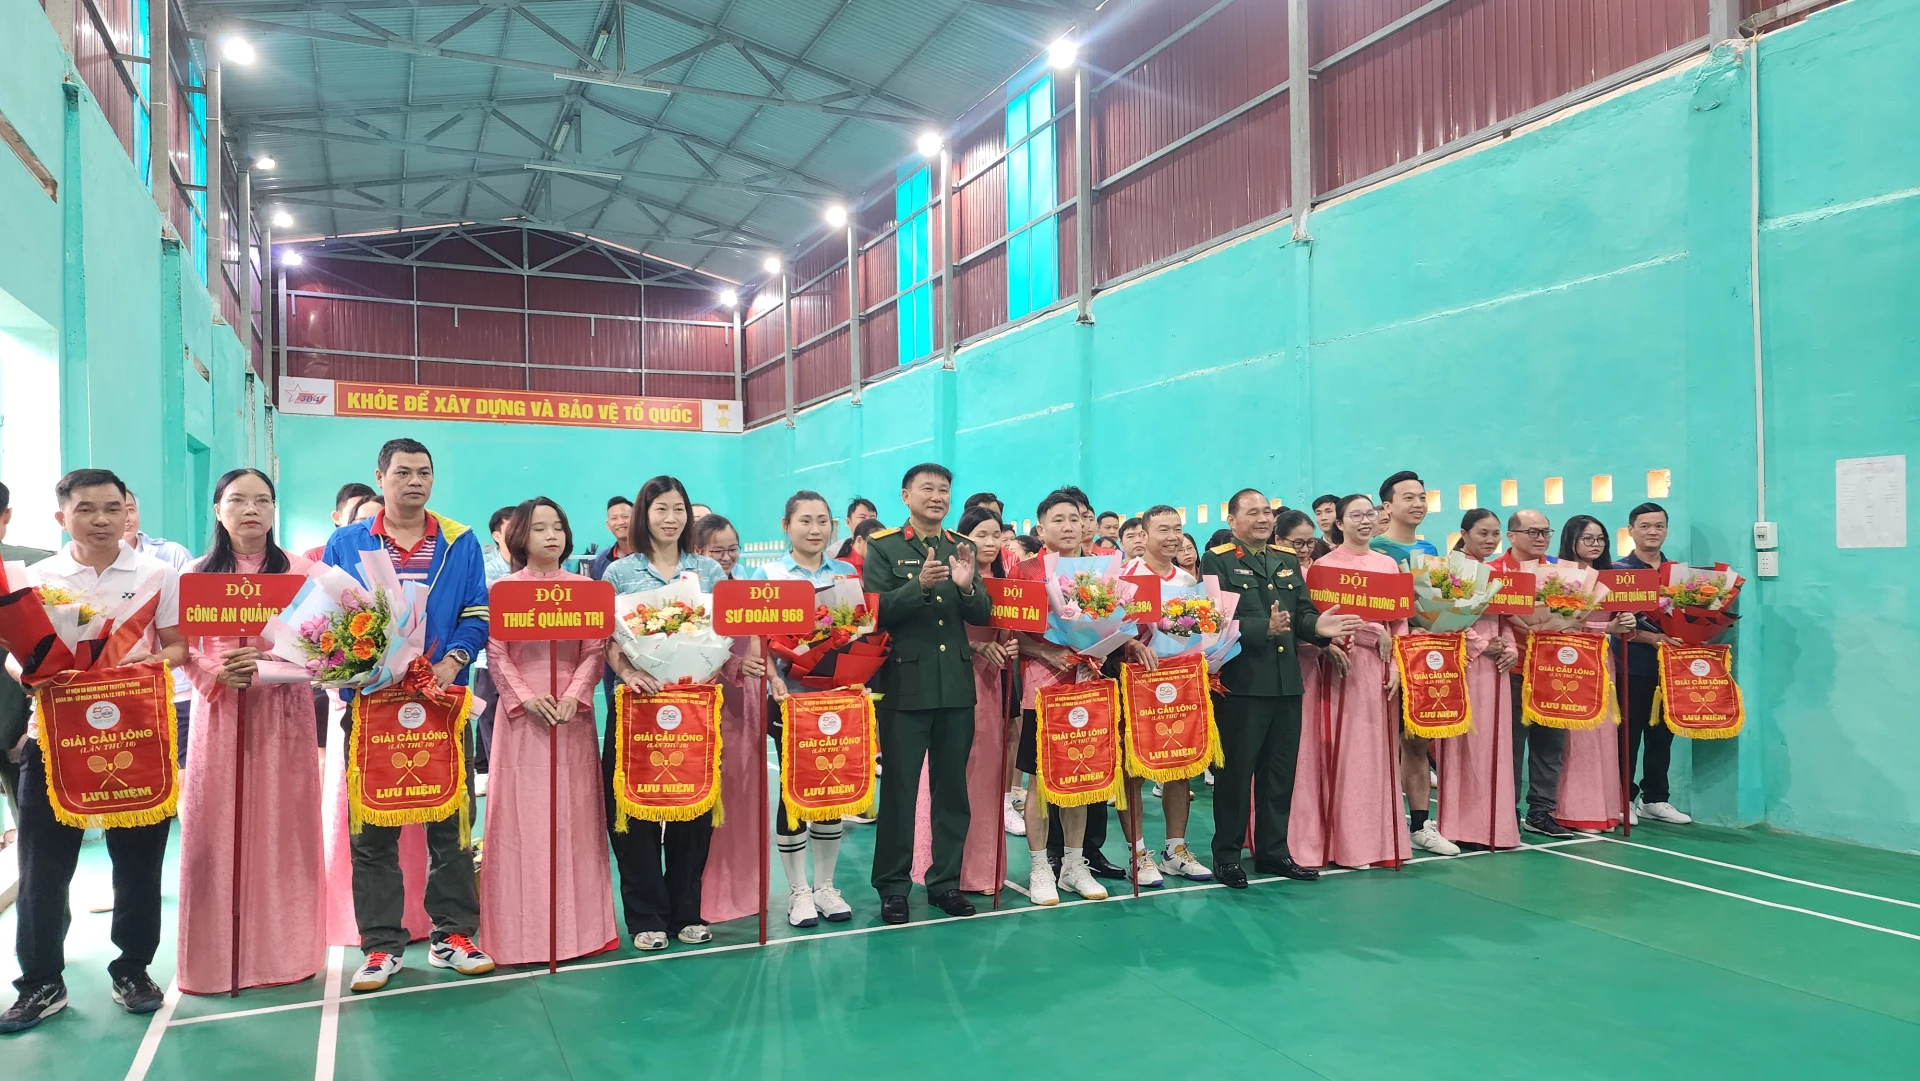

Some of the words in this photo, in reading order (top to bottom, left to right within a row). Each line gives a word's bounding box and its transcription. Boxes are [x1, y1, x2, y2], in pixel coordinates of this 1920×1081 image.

[348, 388, 399, 411] KHỎE
[404, 390, 431, 412] ĐỂ
[434, 394, 471, 414] XÂY
[476, 398, 526, 418] DỰNG
[530, 398, 554, 417] VÀ
[558, 399, 594, 419] BẢO
[598, 402, 619, 423] VỆ
[623, 400, 645, 421] TỔ
[649, 404, 693, 424] QUỐC
[1339, 572, 1368, 589] ĐỘI
[1497, 575, 1513, 589] ỘI
[1616, 571, 1635, 587] ĐỘI
[225, 580, 262, 600] ĐỘI
[535, 583, 572, 606] ĐỘI
[750, 582, 780, 603] ĐỘI
[1003, 584, 1023, 600] ĐỘI
[1629, 588, 1647, 602] QUẢNG
[1648, 591, 1657, 603] TRỊ
[1310, 588, 1340, 604] TRƯỜNG
[1341, 592, 1355, 606] HAI
[1356, 592, 1367, 607] BÀ
[1369, 596, 1395, 611] TRƯNG
[1508, 591, 1524, 605] QUẢNG
[186, 604, 218, 622] CÔNG
[220, 607, 237, 622] AN
[503, 609, 535, 628] THUẾ
[538, 607, 581, 629] QUẢNG
[585, 611, 604, 629] TRỊ
[725, 609, 743, 624] SƯ
[745, 607, 779, 623] ĐOÀN
[782, 608, 804, 623] 968
[991, 604, 1019, 620] RỌNG
[1022, 605, 1040, 620] TÀI
[1538, 664, 1554, 672] GIẢI
[1556, 665, 1573, 674] CẦU
[1574, 668, 1596, 676] LÔNG
[1692, 677, 1707, 685] CẦU
[1140, 707, 1155, 716] GIẢI
[1157, 705, 1174, 714] CẦU
[1176, 704, 1198, 713] LÔNG
[1541, 702, 1560, 710] LƯU
[1561, 704, 1587, 712] NIỆM
[61, 735, 86, 748] GIẢI
[89, 730, 117, 744] CẦU
[120, 729, 153, 740] LÔNG
[371, 732, 395, 744] GIẢI
[397, 729, 420, 742] CẦU
[422, 730, 449, 740] LÔNG
[633, 731, 653, 742] GIẢI
[655, 731, 675, 742] CẦU
[677, 733, 704, 742] LÔNG
[1051, 731, 1068, 741] GIẢI
[1070, 729, 1087, 739] CẦU
[1088, 727, 1108, 736] LÔNG
[798, 738, 817, 748] GIẢI
[819, 736, 837, 746] CẦU
[840, 736, 861, 745] LÔNG
[1149, 750, 1168, 760] LƯU
[1170, 746, 1197, 758] NIỆM
[1059, 775, 1078, 785] LƯU
[1080, 771, 1104, 783] NIỆM
[81, 791, 109, 803] LƯU
[113, 786, 153, 800] NIỆM
[376, 787, 403, 799] LƯU
[405, 782, 441, 798] NIỆM
[637, 784, 661, 794] LƯU
[663, 782, 695, 795] NIỆM
[803, 787, 827, 797] LƯU
[828, 783, 855, 796] NIỆM
